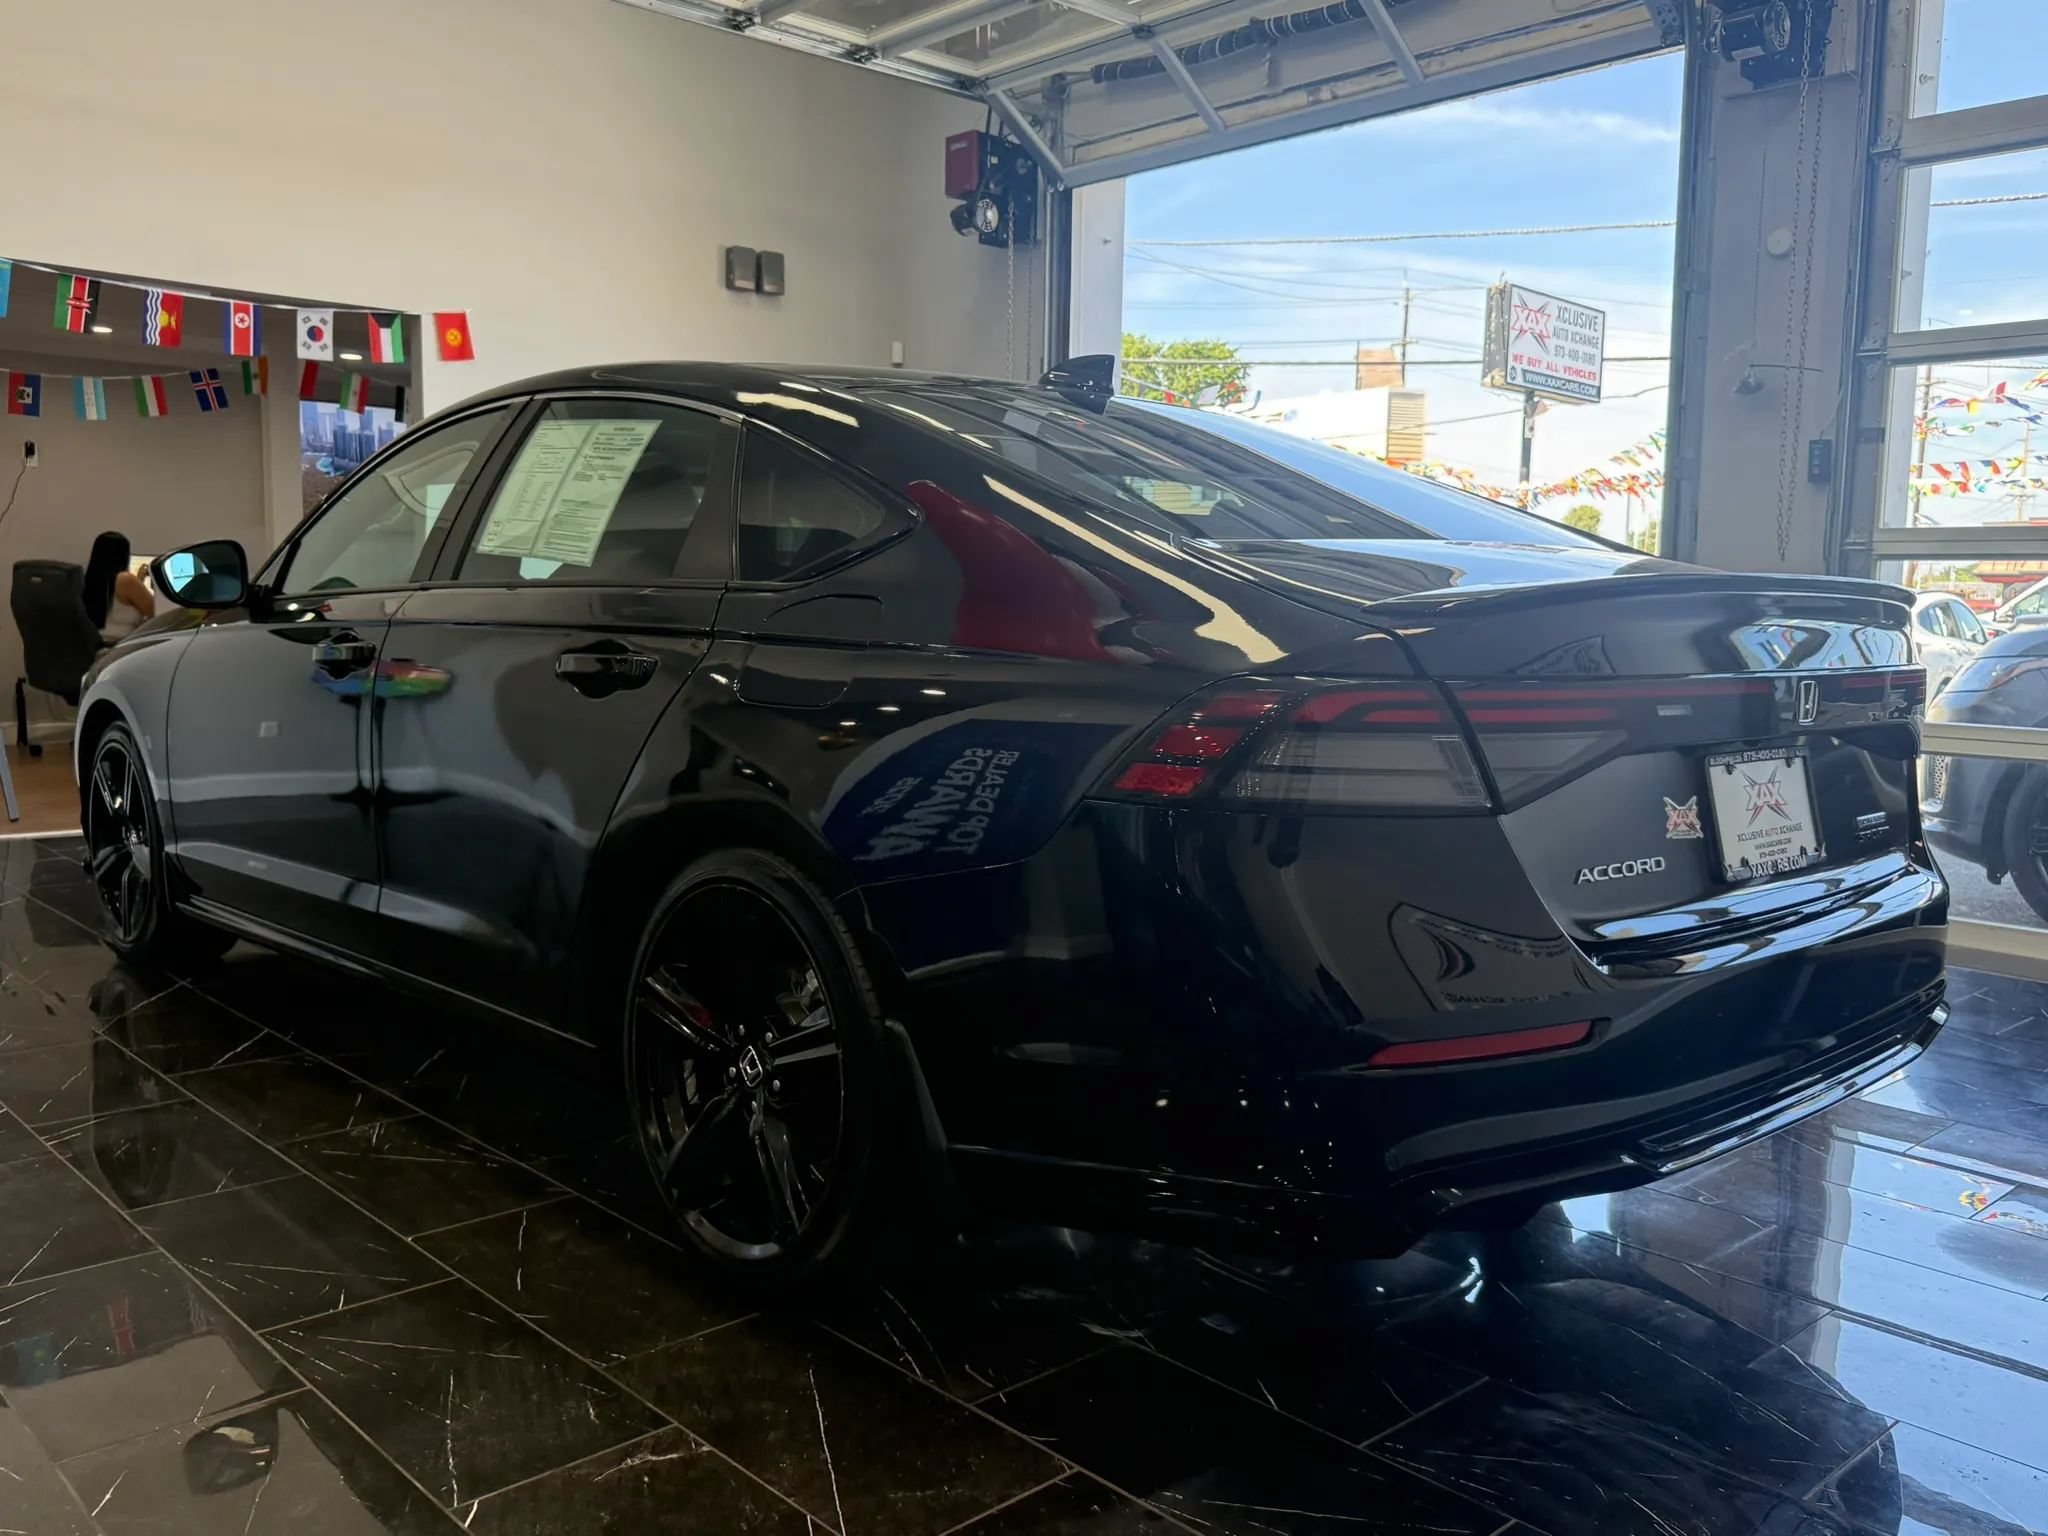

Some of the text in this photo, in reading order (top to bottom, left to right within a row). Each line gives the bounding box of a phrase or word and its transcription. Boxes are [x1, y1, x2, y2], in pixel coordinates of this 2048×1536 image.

[1556, 304, 1599, 332] XCLUSIVE
[1553, 326, 1600, 350] AUTO XCHANGE
[1512, 353, 1597, 381] WE BUY ALL VEHICLES
[1736, 822, 1803, 843] XCLUSIVE AUTO XCHANGE
[1578, 856, 1665, 884] ACCORD
